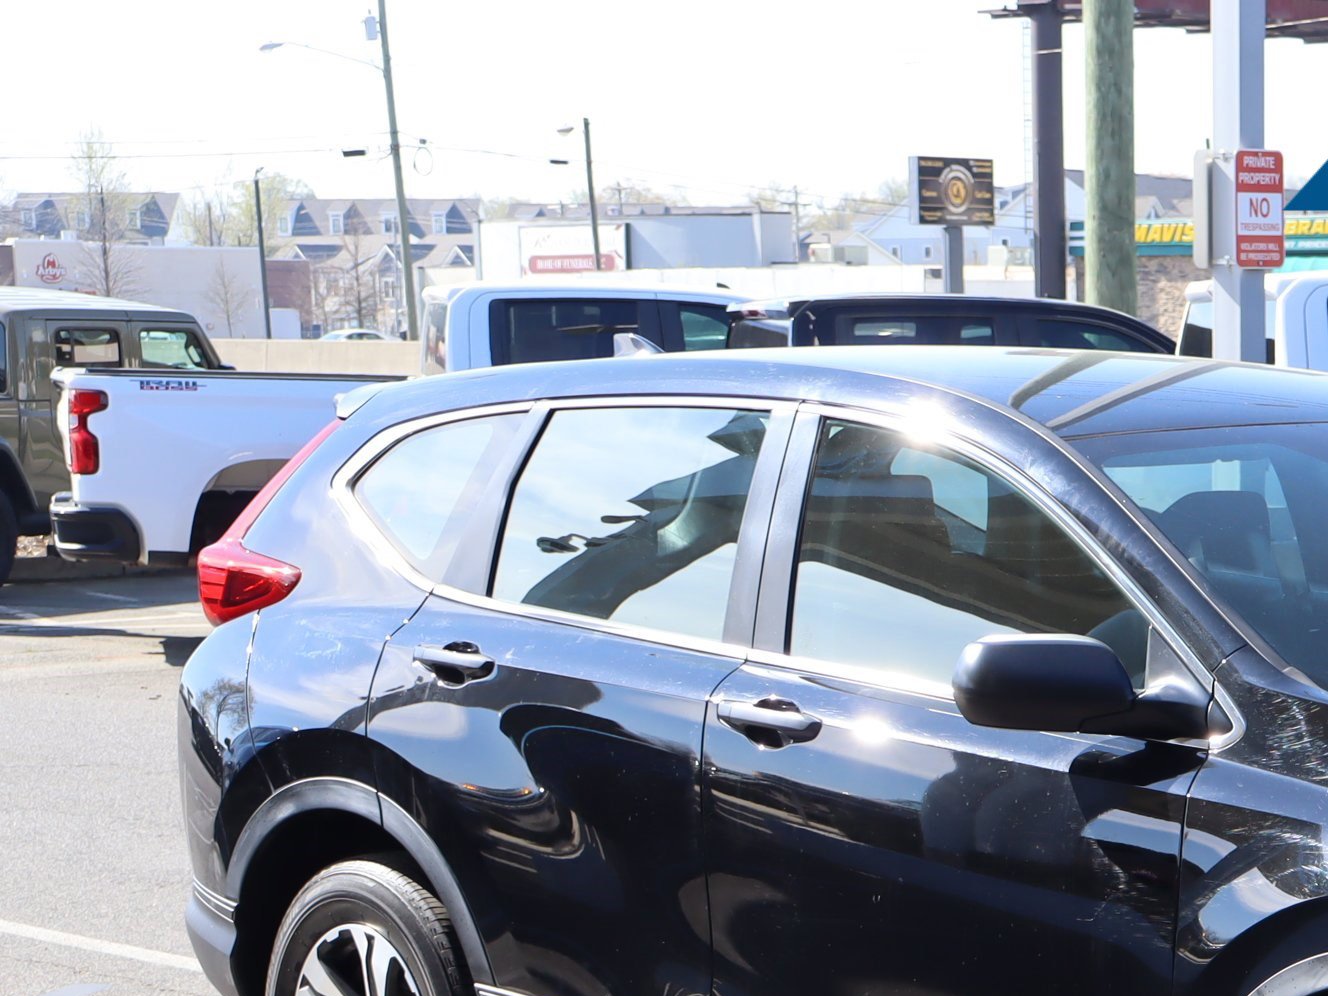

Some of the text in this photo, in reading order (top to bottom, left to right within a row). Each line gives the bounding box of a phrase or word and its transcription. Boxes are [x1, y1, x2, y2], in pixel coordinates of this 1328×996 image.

[1243, 156, 1276, 168] PRIVATE
[1239, 172, 1281, 185] PROPERTY
[1249, 197, 1270, 218] NO
[1240, 222, 1280, 231] TRESPASSING
